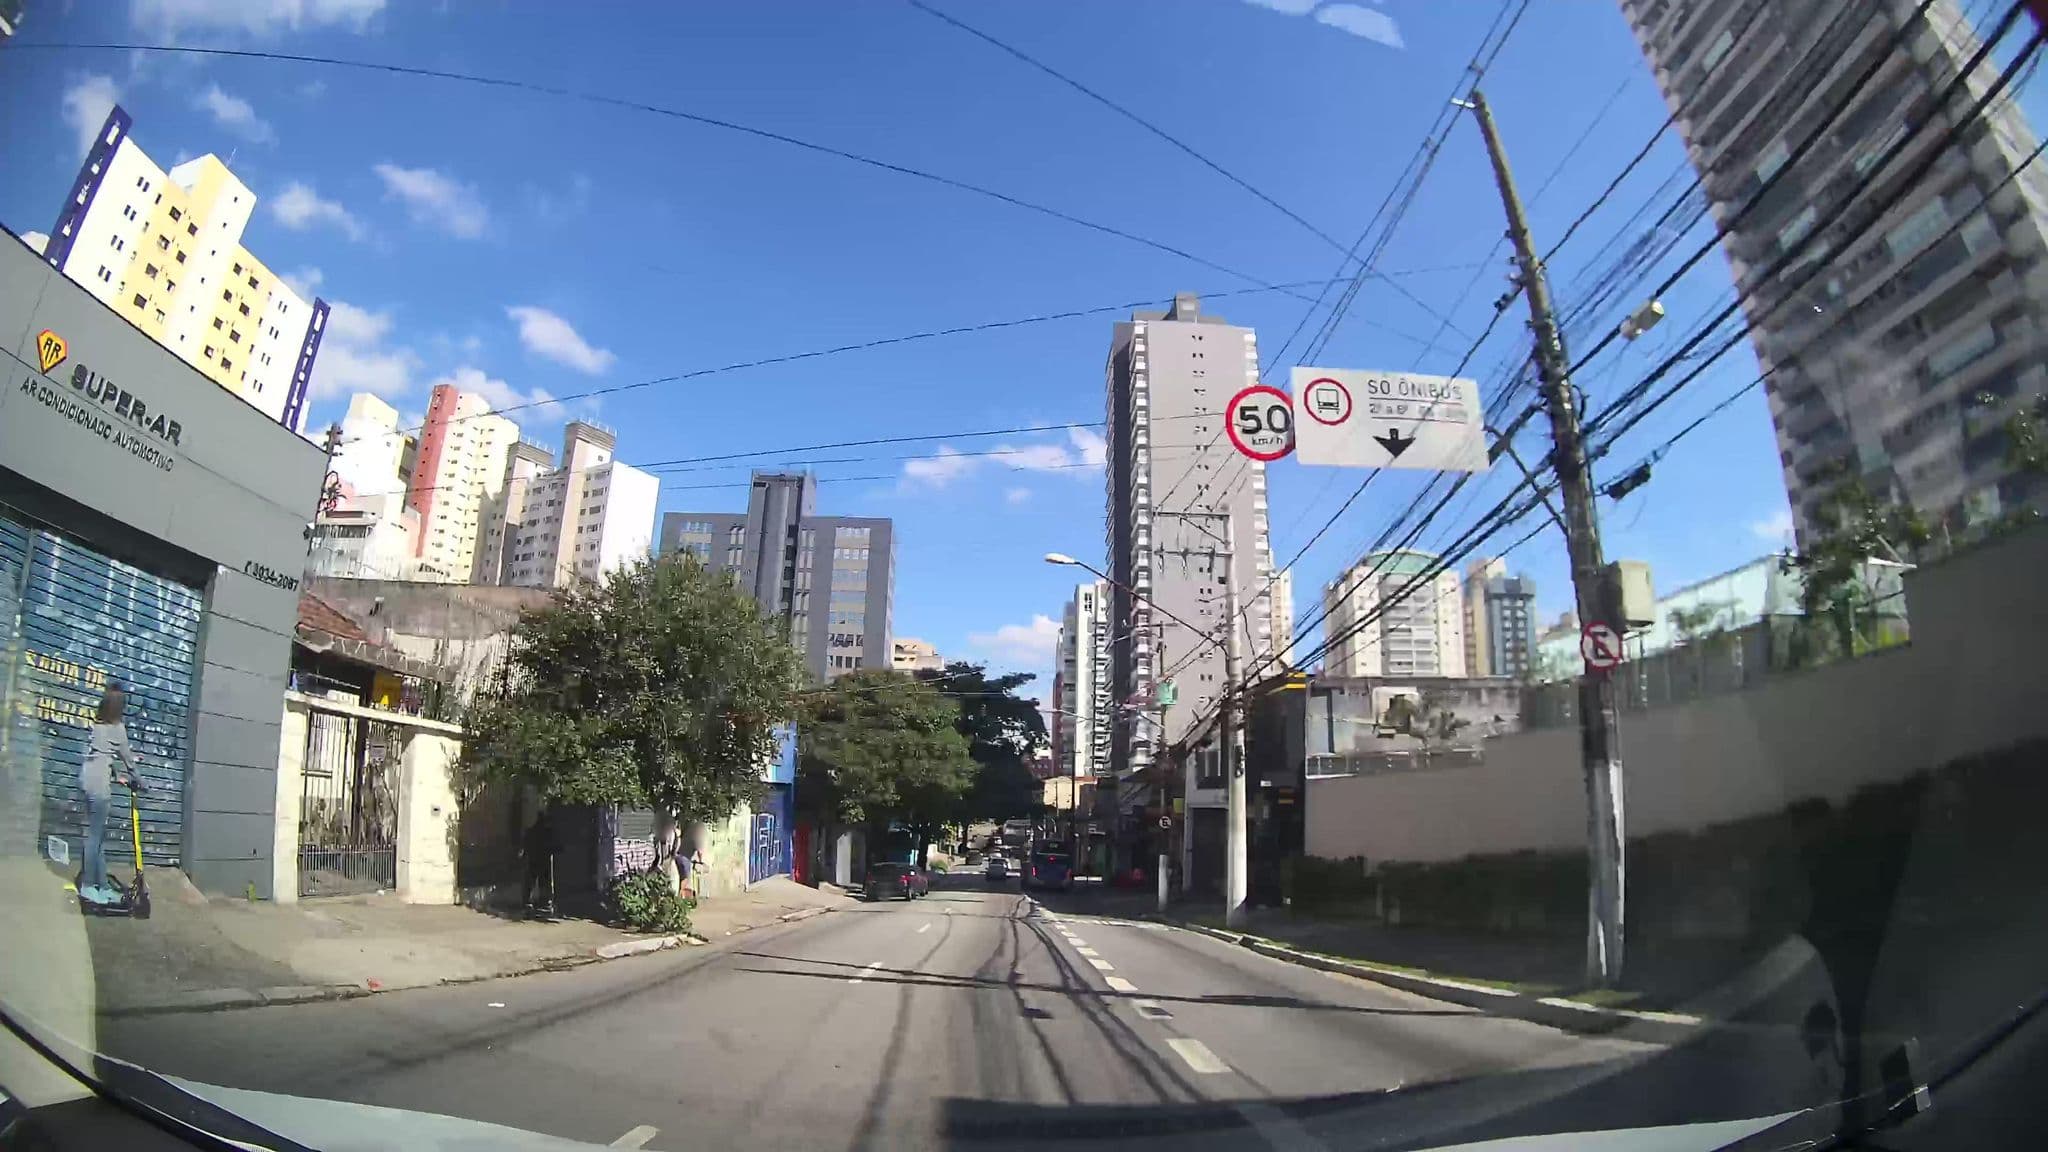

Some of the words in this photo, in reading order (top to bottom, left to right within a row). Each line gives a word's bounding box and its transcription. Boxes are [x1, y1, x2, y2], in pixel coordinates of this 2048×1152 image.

[1398, 377, 1462, 400] ÔNIBUS
[71, 363, 183, 447] SUPER-AR
[1239, 404, 1291, 434] 50
[20, 376, 38, 398] AR
[37, 386, 112, 441] CONDICIONADO
[112, 431, 175, 472] AUTOMOTIVO
[1251, 436, 1283, 446] km/h
